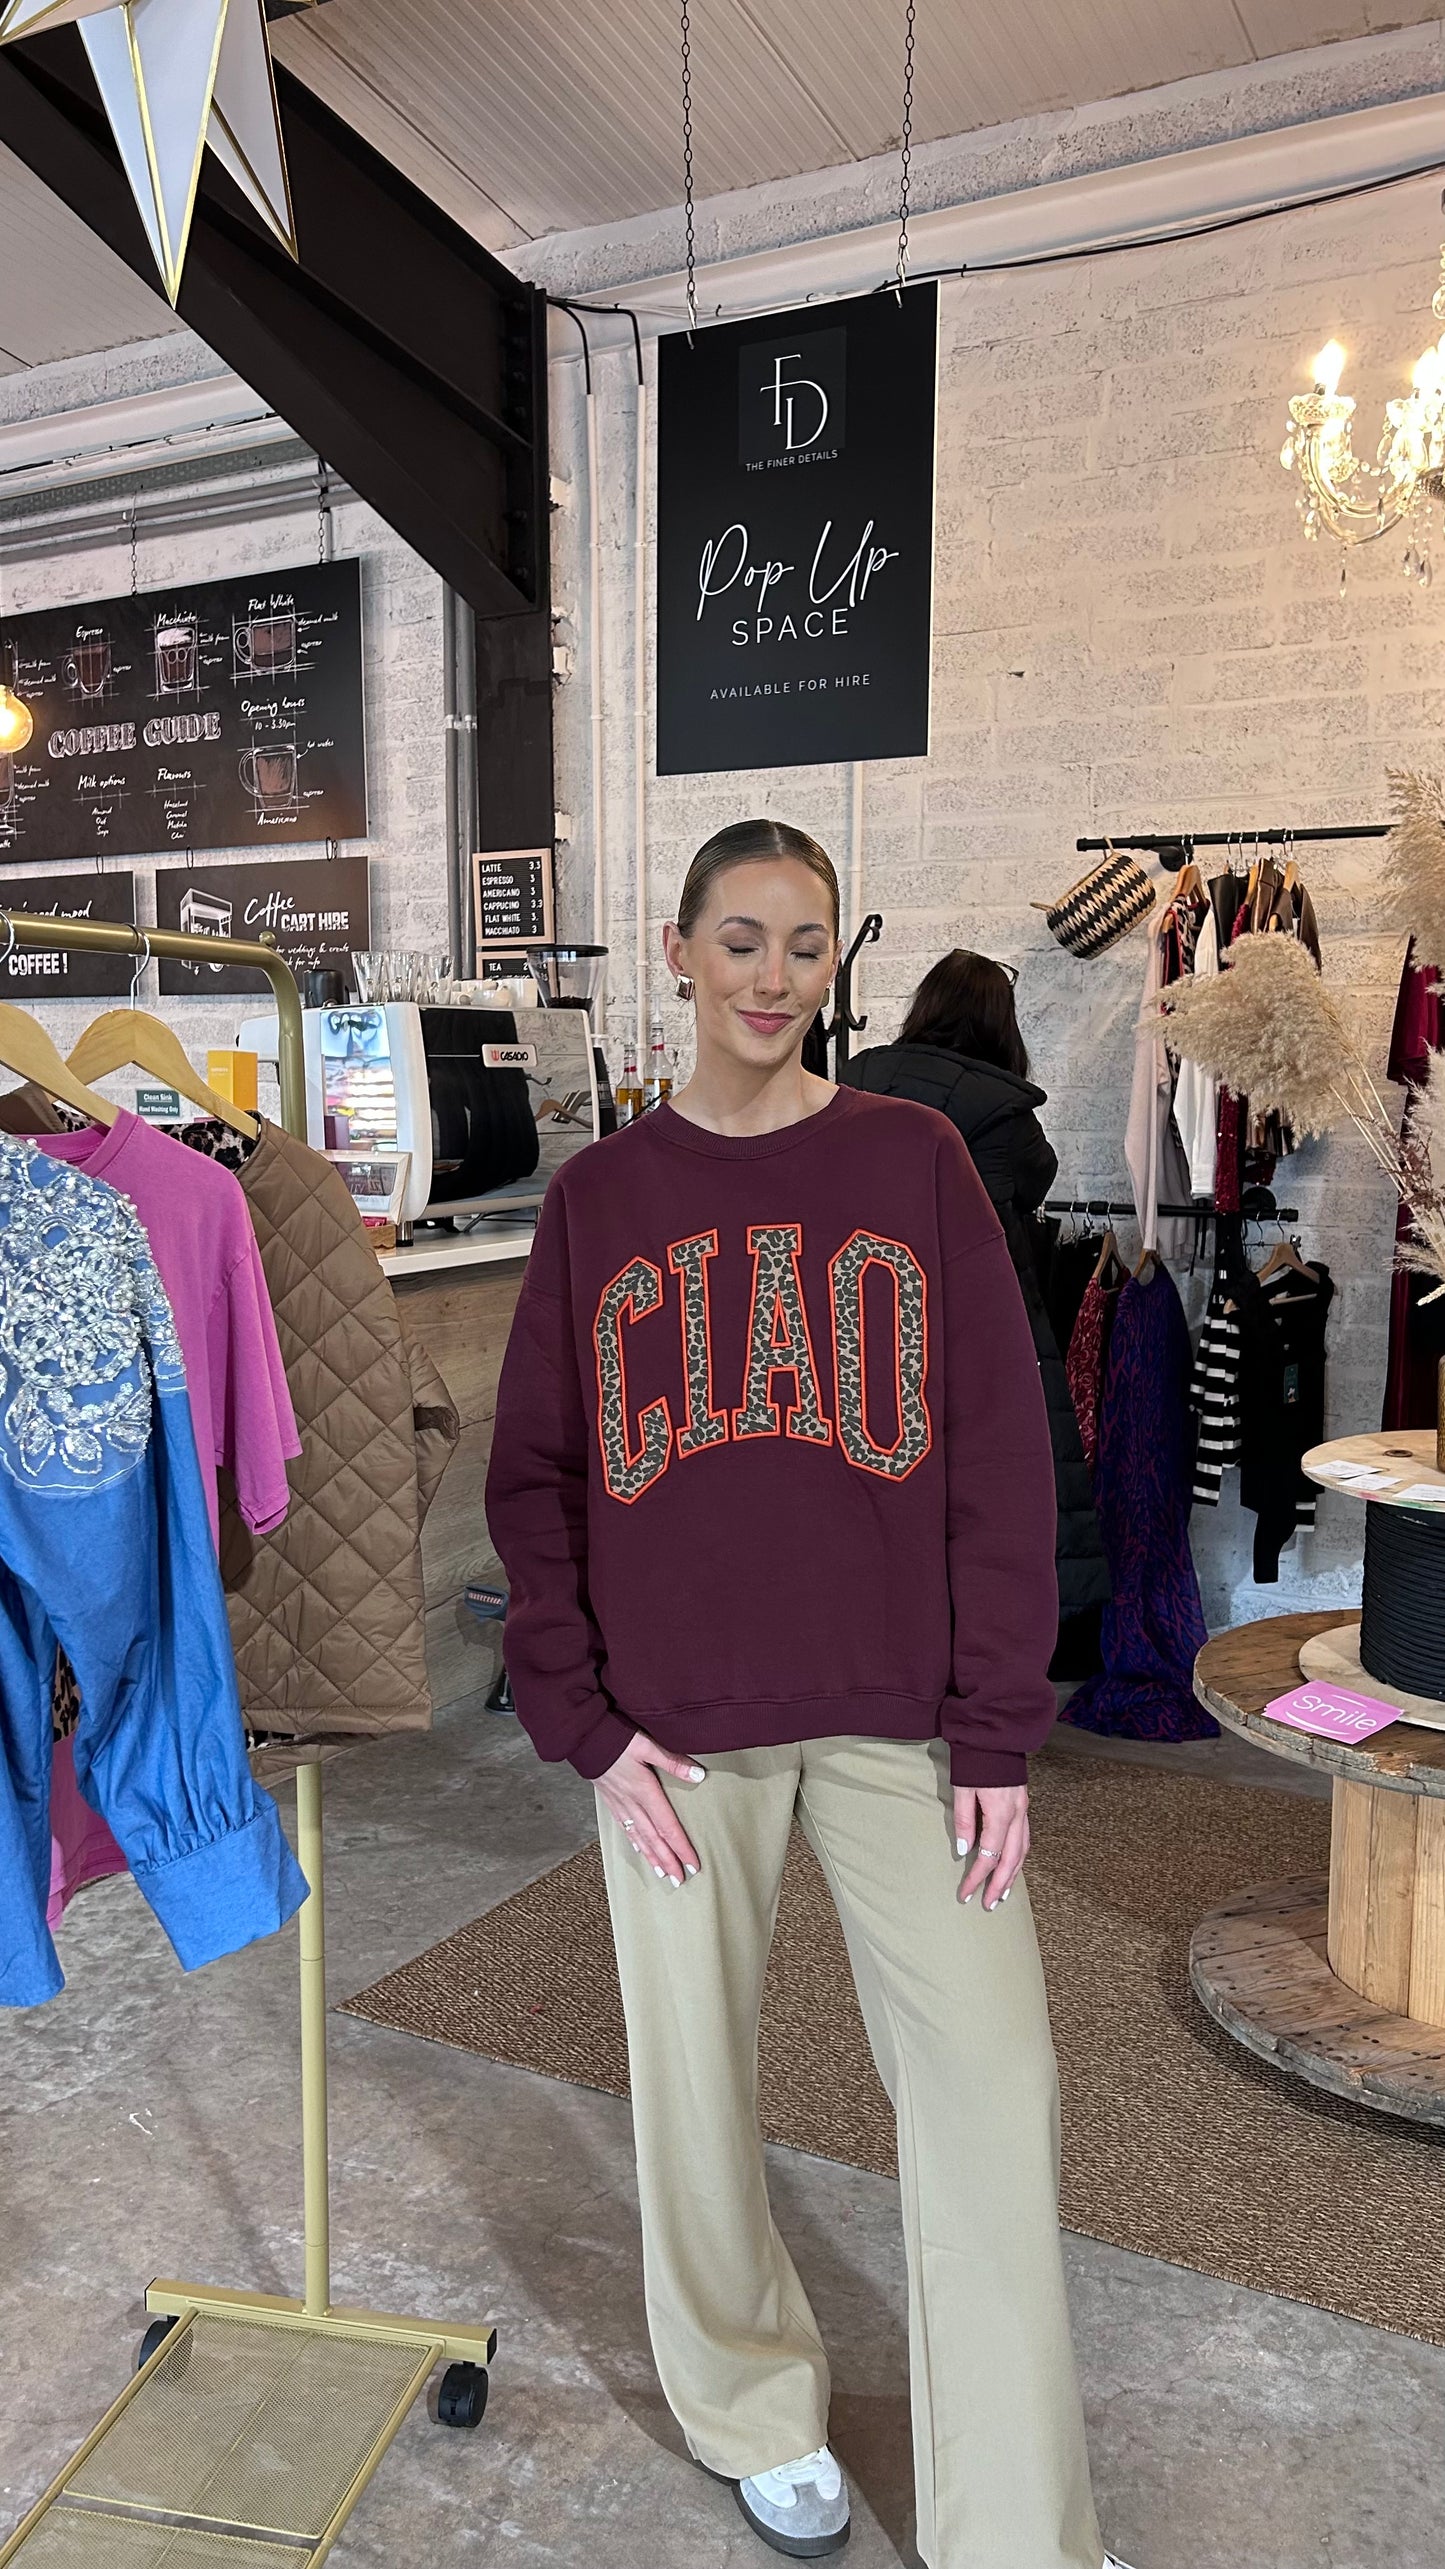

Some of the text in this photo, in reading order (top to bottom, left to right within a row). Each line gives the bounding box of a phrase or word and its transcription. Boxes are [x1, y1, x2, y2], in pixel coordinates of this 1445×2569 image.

[745, 449, 838, 472] THE FINER DETAILS
[697, 520, 900, 621] Pop Up
[247, 598, 267, 611] Flat
[731, 607, 849, 646] SPACE
[710, 673, 872, 700] AVAILABLE FOR HIRE
[241, 698, 278, 717] Opening
[47, 711, 223, 759] COFFEE GUIDE
[77, 773, 126, 791] Milk options
[481, 863, 502, 873] LATTE
[482, 873, 536, 886] ESPRESSO 3
[482, 886, 536, 898] AMERICANO 3
[243, 891, 296, 928] Coffee
[483, 901, 520, 910] CAPPUCINO
[280, 911, 350, 933] CART HIRE
[485, 914, 500, 923] FLAT
[502, 913, 521, 923] WHITE
[485, 924, 538, 936] MACCHIATO 3
[8, 953, 60, 976] COFFEE
[488, 962, 502, 971] TEA
[143, 1093, 173, 1101] Clean Sink
[592, 1223, 932, 1506] CIAO
